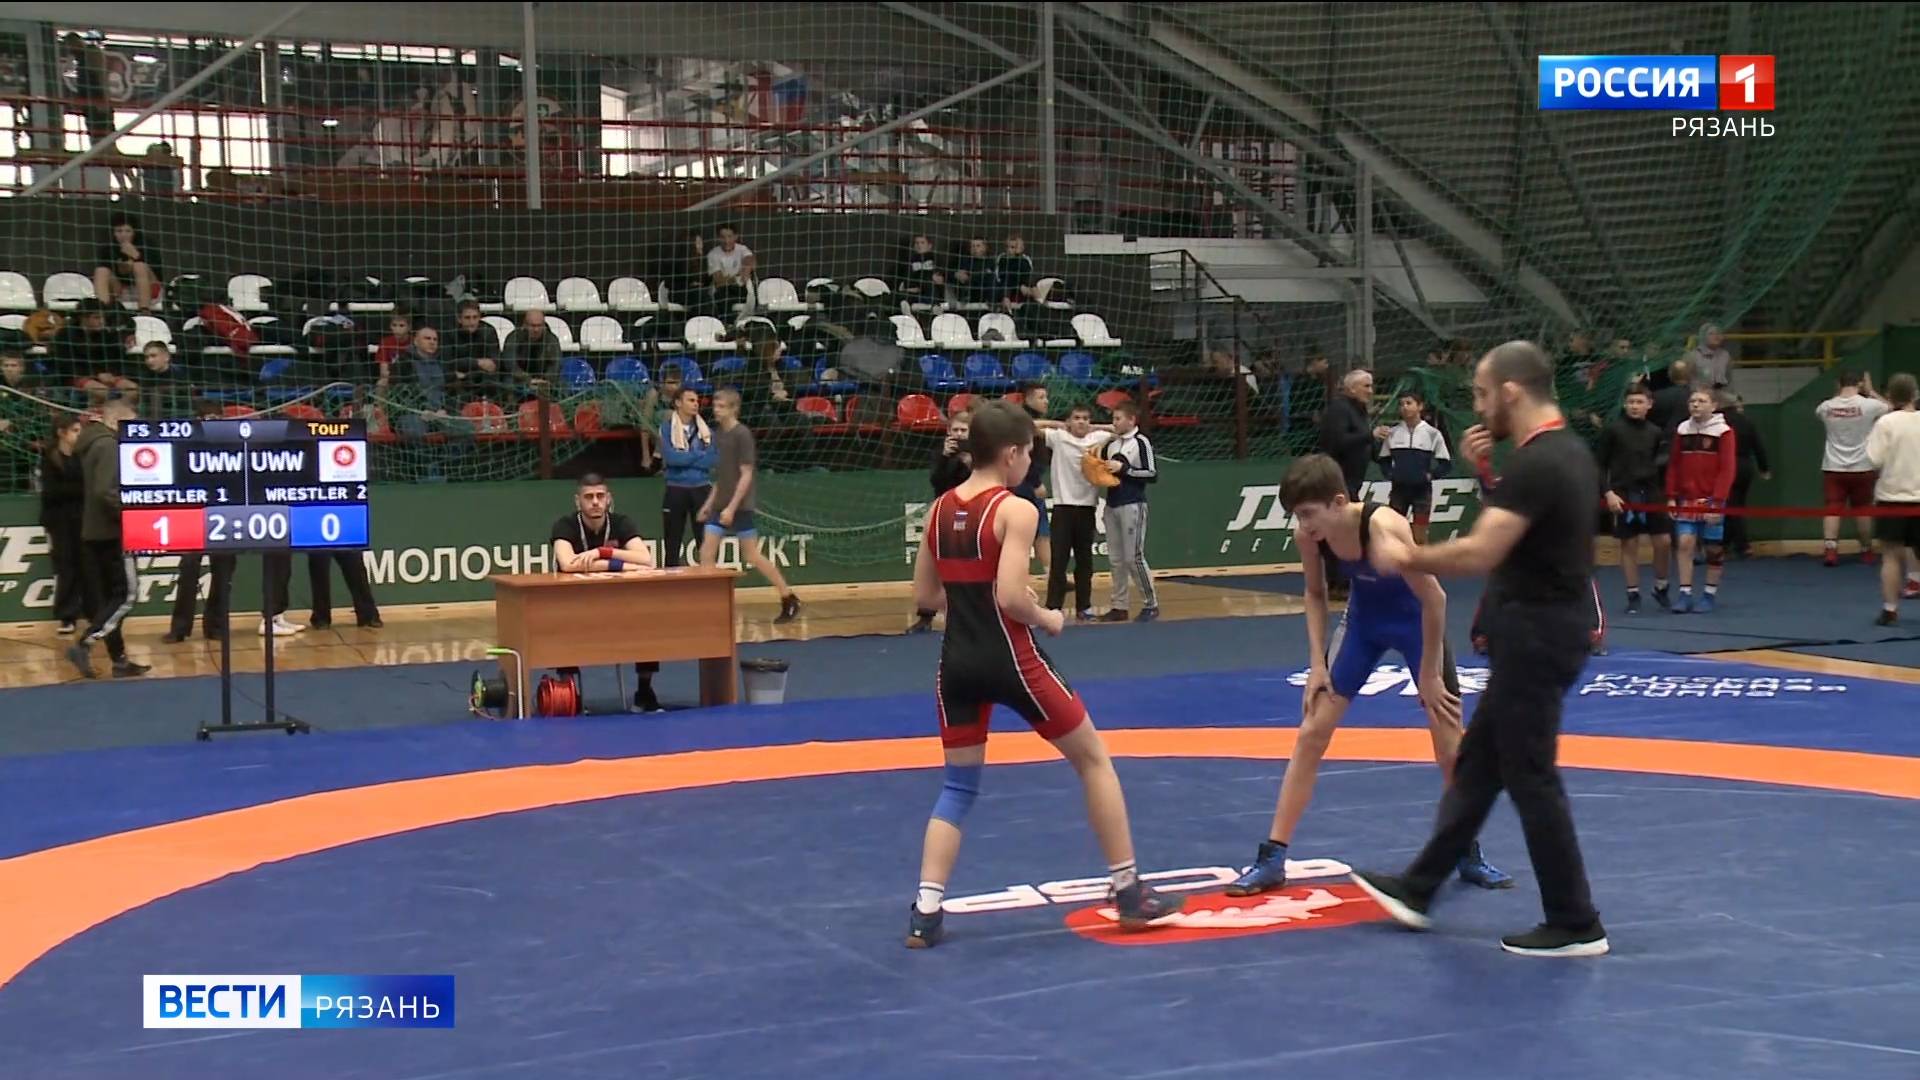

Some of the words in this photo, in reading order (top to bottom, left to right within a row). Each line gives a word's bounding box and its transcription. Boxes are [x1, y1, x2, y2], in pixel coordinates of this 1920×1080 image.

[127, 424, 150, 437] FS
[159, 421, 192, 438] 120
[307, 422, 349, 436] Tour
[188, 451, 243, 473] UWW
[250, 450, 304, 472] UWW
[120, 488, 208, 504] WRESTLER
[216, 487, 229, 502] 1
[265, 486, 348, 501] WRESTLER
[356, 484, 367, 500] 2
[152, 516, 170, 545] 1
[208, 512, 287, 541] 2:00
[321, 512, 341, 541] 0
[362, 543, 557, 585] МОЛОЧН
